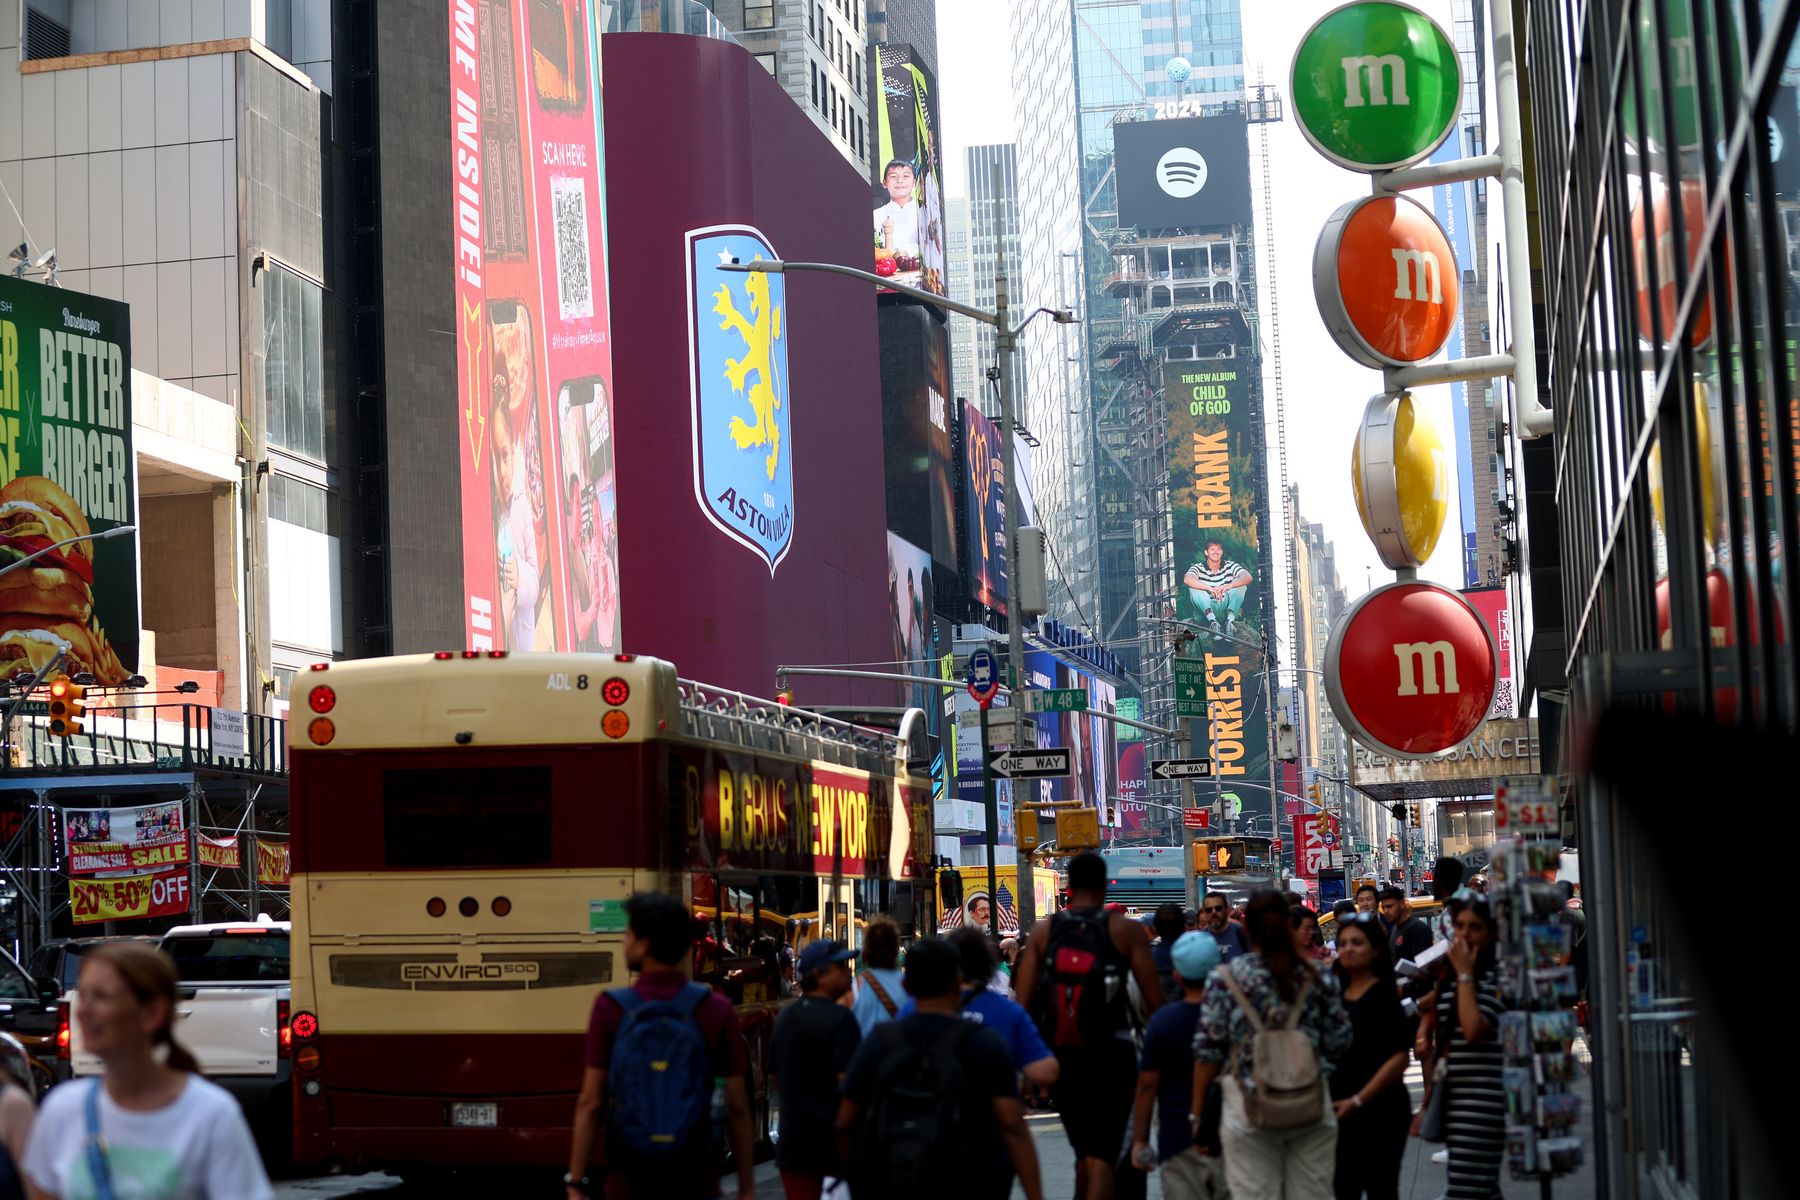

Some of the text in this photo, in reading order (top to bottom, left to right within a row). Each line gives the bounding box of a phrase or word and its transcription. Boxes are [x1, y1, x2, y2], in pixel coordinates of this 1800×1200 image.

[542, 141, 587, 167] SCAN HERE
[456, 87, 482, 289] INSIDE!
[0, 319, 20, 411] R
[39, 327, 124, 430] BETTER
[1181, 371, 1237, 384] THE NEW ALBUM
[1193, 384, 1226, 401] CHILD
[1190, 399, 1231, 416] OF GOD
[41, 422, 128, 523] BURGER
[1193, 430, 1232, 529] FRANK
[717, 487, 790, 542] ASTON VILLA
[546, 673, 589, 690] ADL 8
[1179, 674, 1202, 685] USE 7 AVE
[1044, 693, 1054, 707] W
[1058, 692, 1073, 708] 48
[1178, 702, 1205, 712] BEST ROUTE
[1205, 653, 1246, 777] FORREST
[1353, 737, 1529, 769] REANCE
[1000, 757, 1061, 771] ONE WAY
[1162, 763, 1205, 774] ONE WAY
[72, 844, 100, 854] STORE
[131, 843, 188, 867] SALE
[73, 853, 128, 870] CLEARANCE SALE
[73, 882, 109, 916] 20%
[113, 880, 150, 912] 50%
[151, 876, 188, 905] OFF
